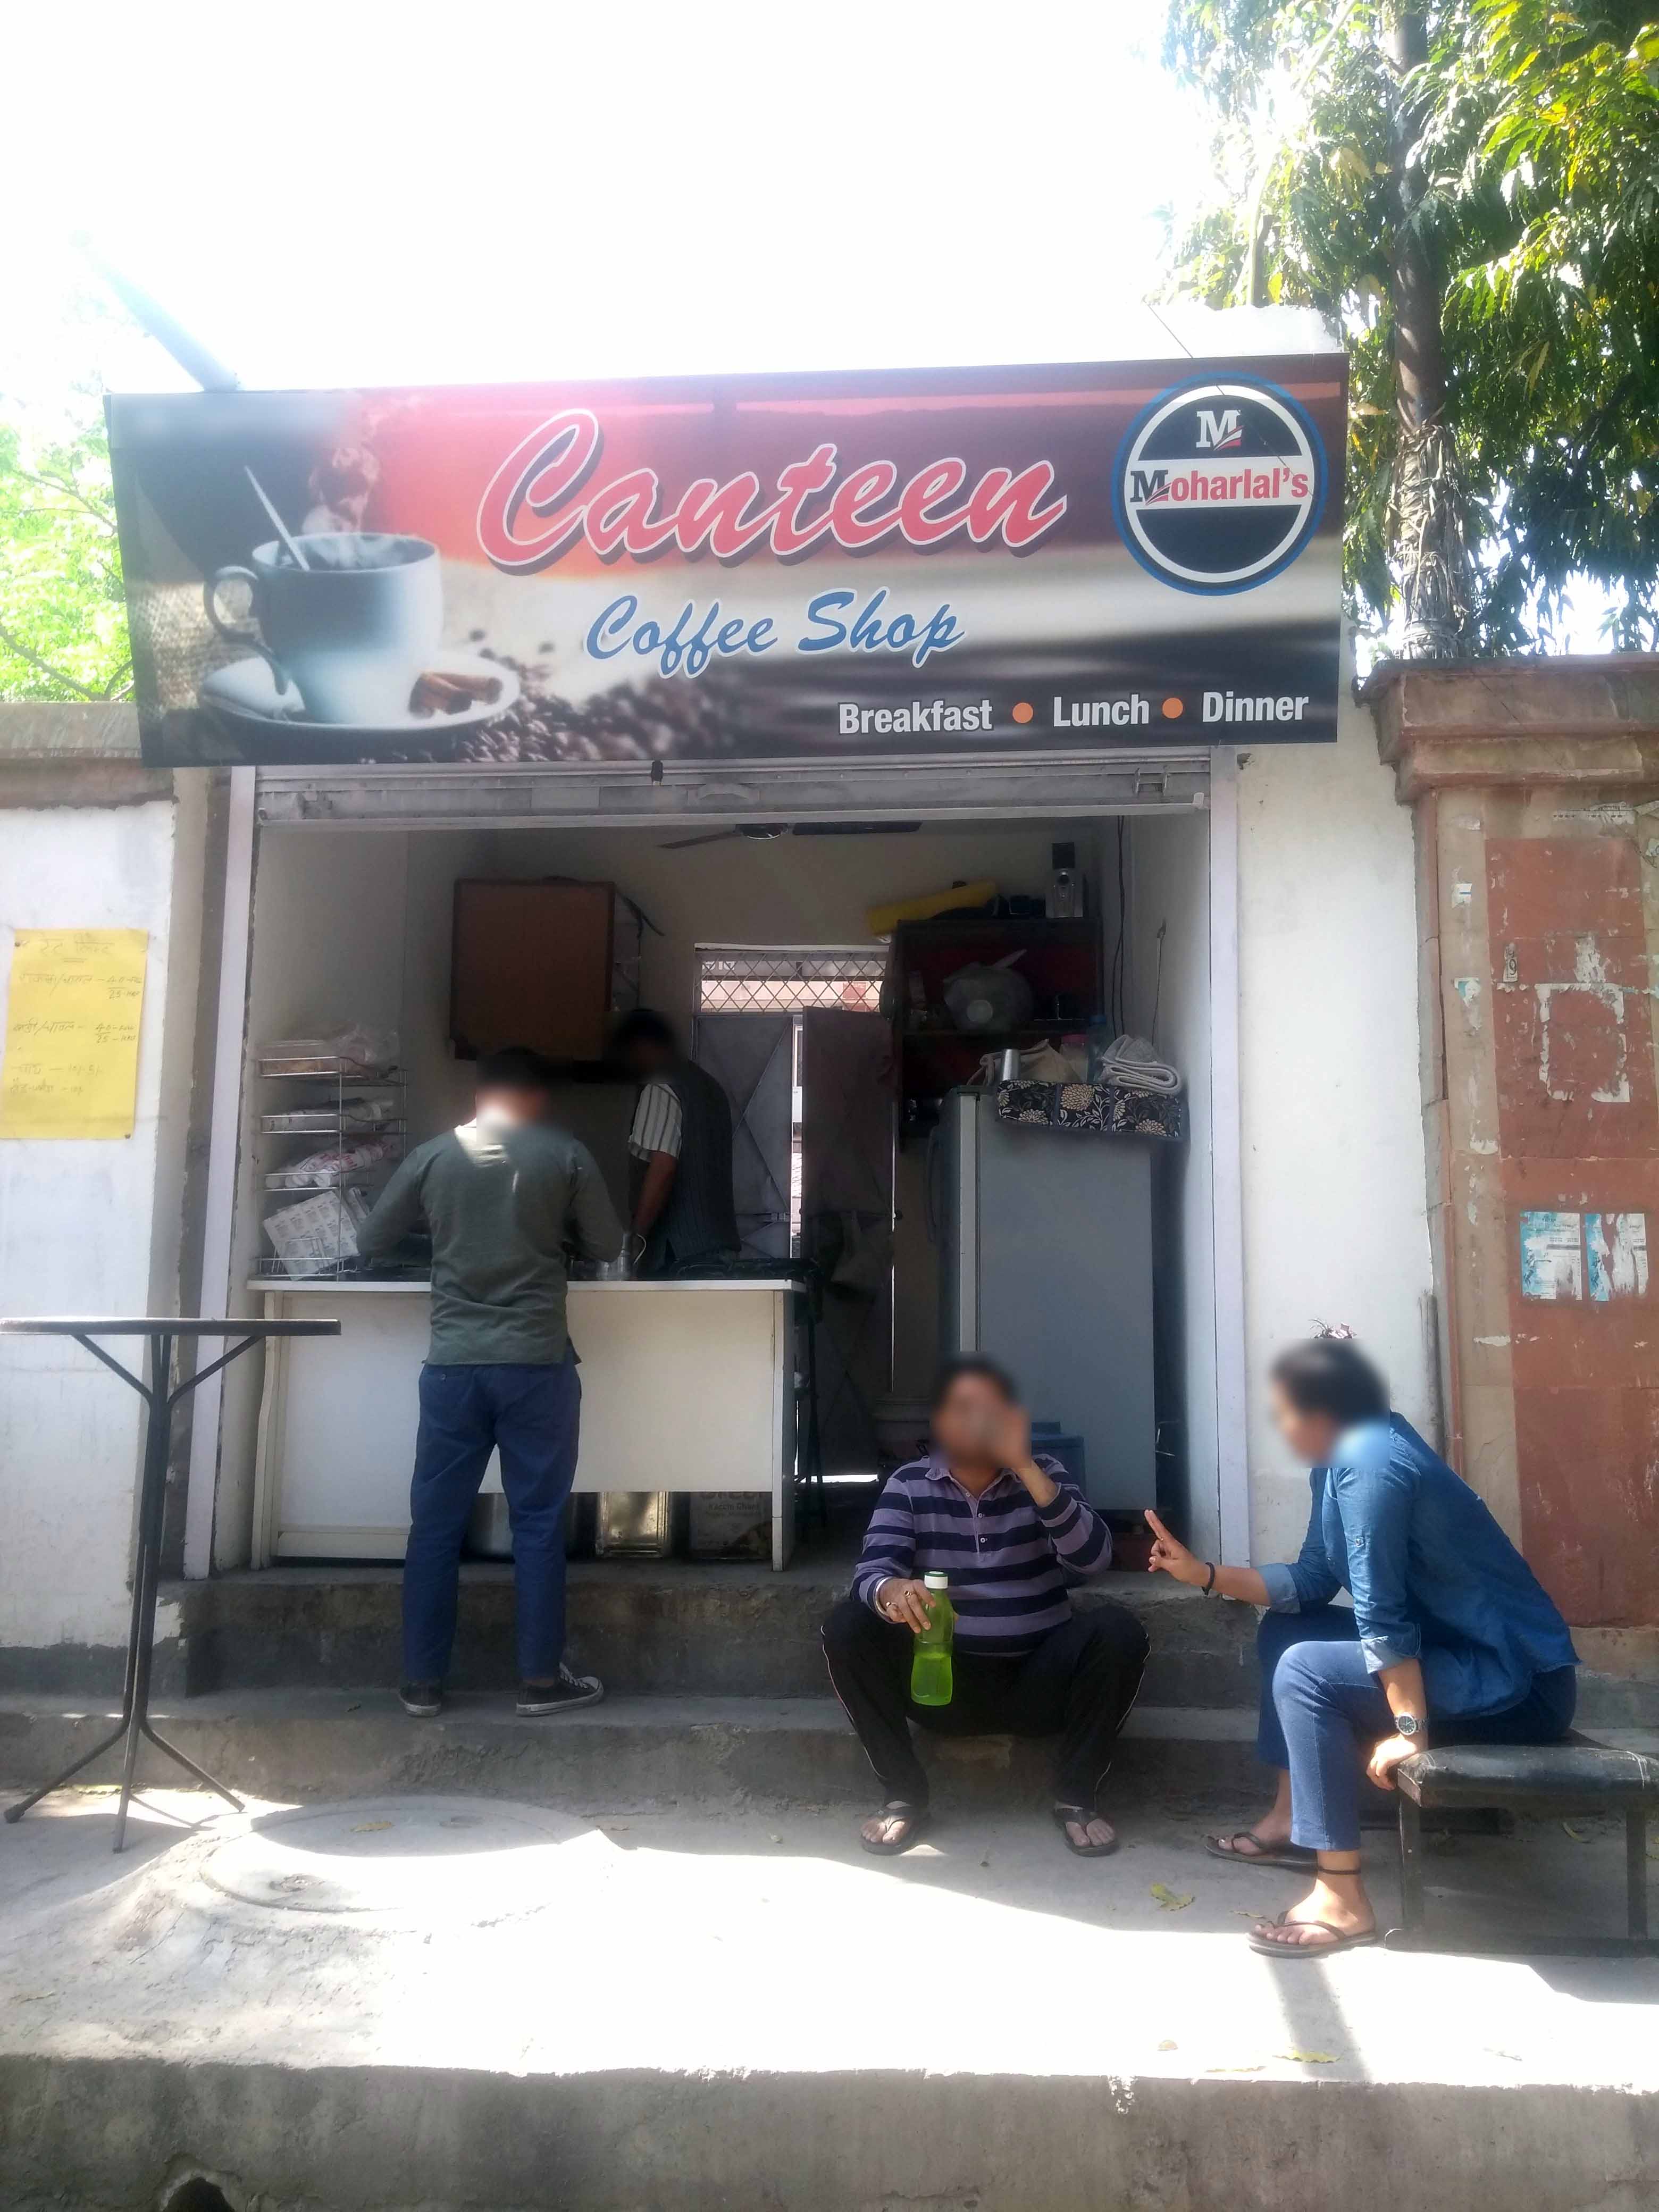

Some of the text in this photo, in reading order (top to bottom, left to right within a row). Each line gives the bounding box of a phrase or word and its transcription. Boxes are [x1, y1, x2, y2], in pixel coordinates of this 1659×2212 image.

[476, 408, 1067, 568] Canteen
[1129, 467, 1309, 505] Moharlal's
[585, 586, 967, 678] Coffee Shop
[839, 691, 1310, 735] Breakfast Lunch Dinner
